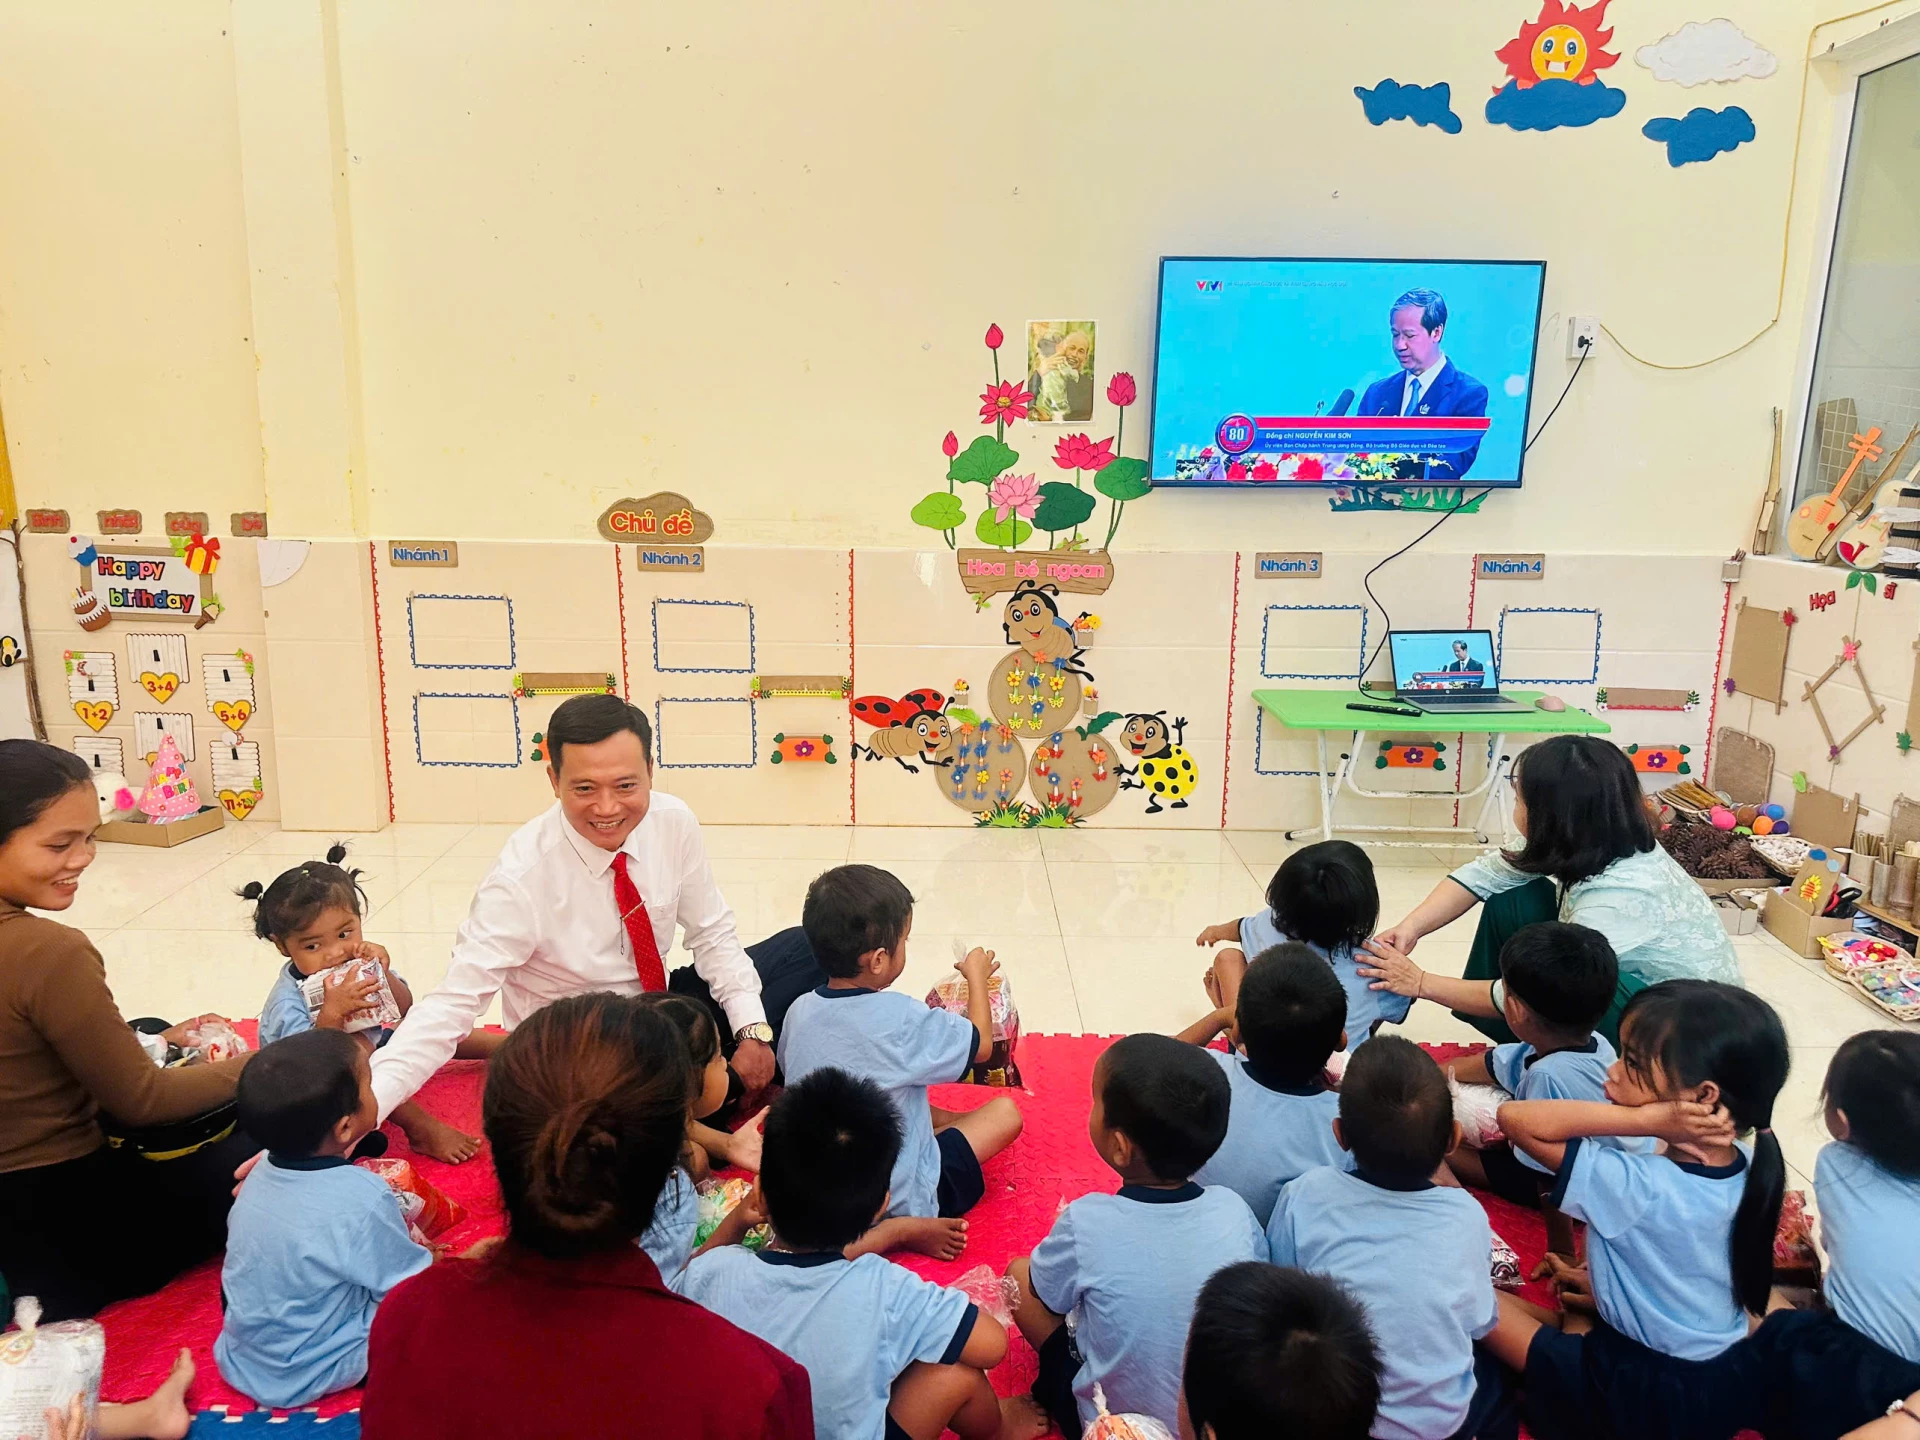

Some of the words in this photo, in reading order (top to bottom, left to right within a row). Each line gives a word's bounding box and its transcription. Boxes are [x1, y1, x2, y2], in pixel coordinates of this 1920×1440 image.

[1196, 281, 1222, 291] VTV1
[1229, 428, 1244, 440] 80
[1295, 431, 1323, 439] NGUYỄN
[609, 510, 656, 535] Chủ
[662, 509, 695, 536] đề
[392, 547, 440, 562] Nhánh
[442, 549, 449, 562] 1
[642, 551, 689, 566] Nhánh
[691, 553, 701, 566] 2
[98, 556, 165, 580] Happy
[967, 559, 1005, 576] Hoa
[1014, 559, 1039, 577] bé
[1047, 563, 1105, 582] ngoan
[1260, 557, 1306, 572] Nhánh
[1309, 560, 1318, 572] 3
[1532, 561, 1541, 573] 4
[109, 588, 194, 613] birthday
[1809, 590, 1836, 612] Họa
